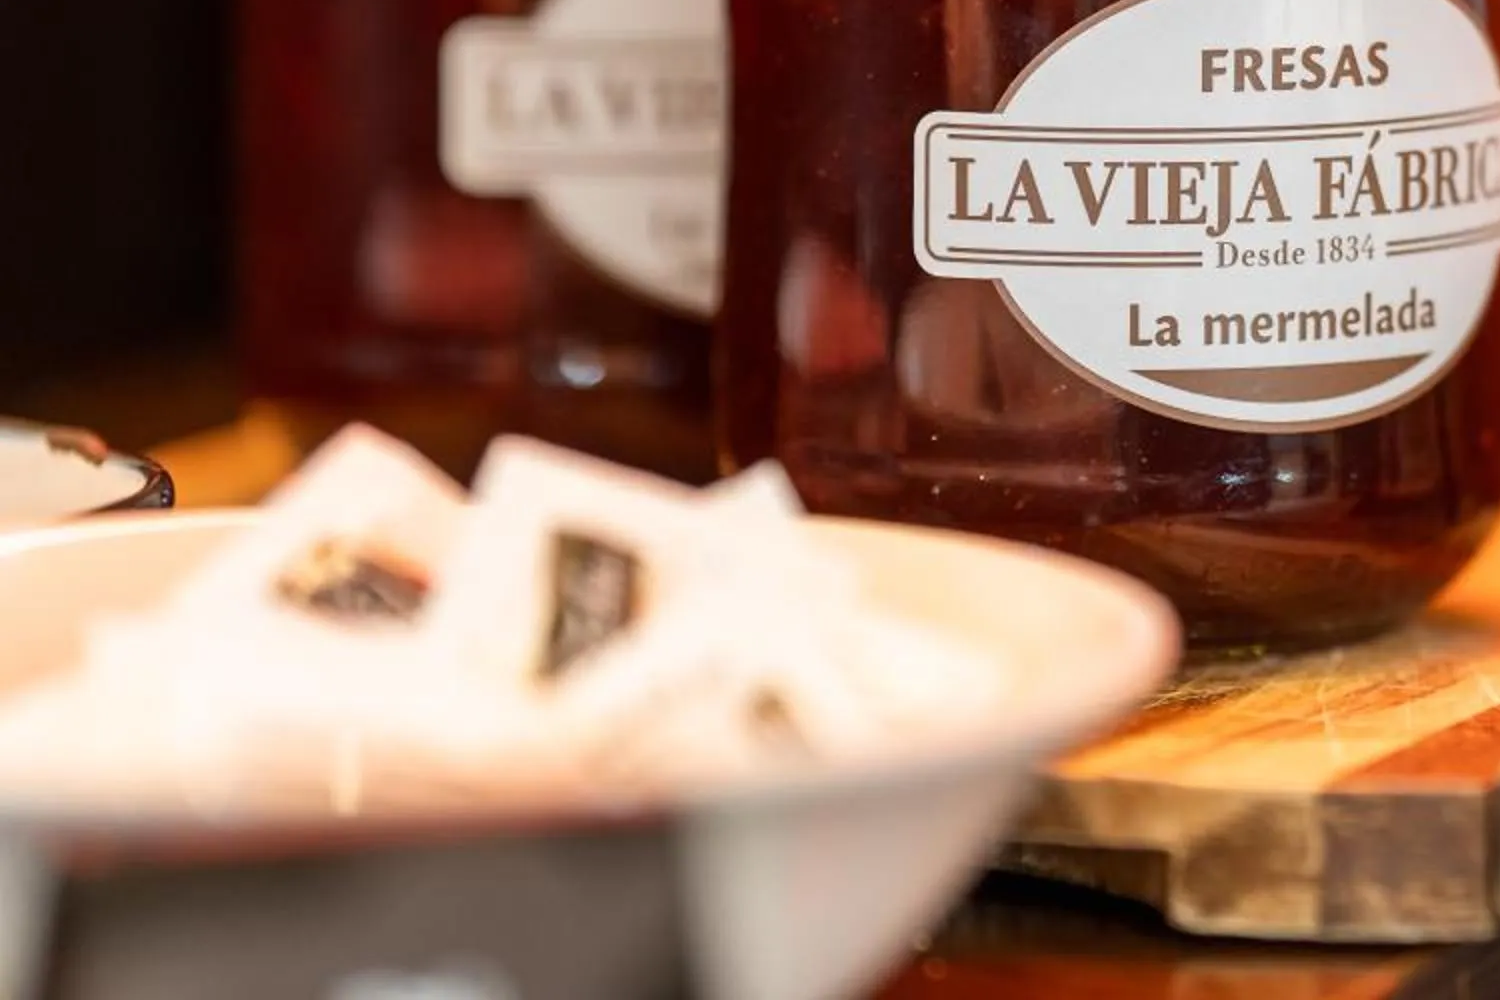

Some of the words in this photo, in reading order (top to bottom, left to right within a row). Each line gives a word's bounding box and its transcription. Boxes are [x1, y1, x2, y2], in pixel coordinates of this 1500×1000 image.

[1201, 41, 1390, 93] FRESAS
[947, 156, 1055, 226] LA
[1064, 157, 1293, 238] VIEJA
[1216, 240, 1306, 269] Desde
[1316, 232, 1375, 265] 1834
[1129, 303, 1181, 348] La
[1203, 287, 1437, 346] mermelada
